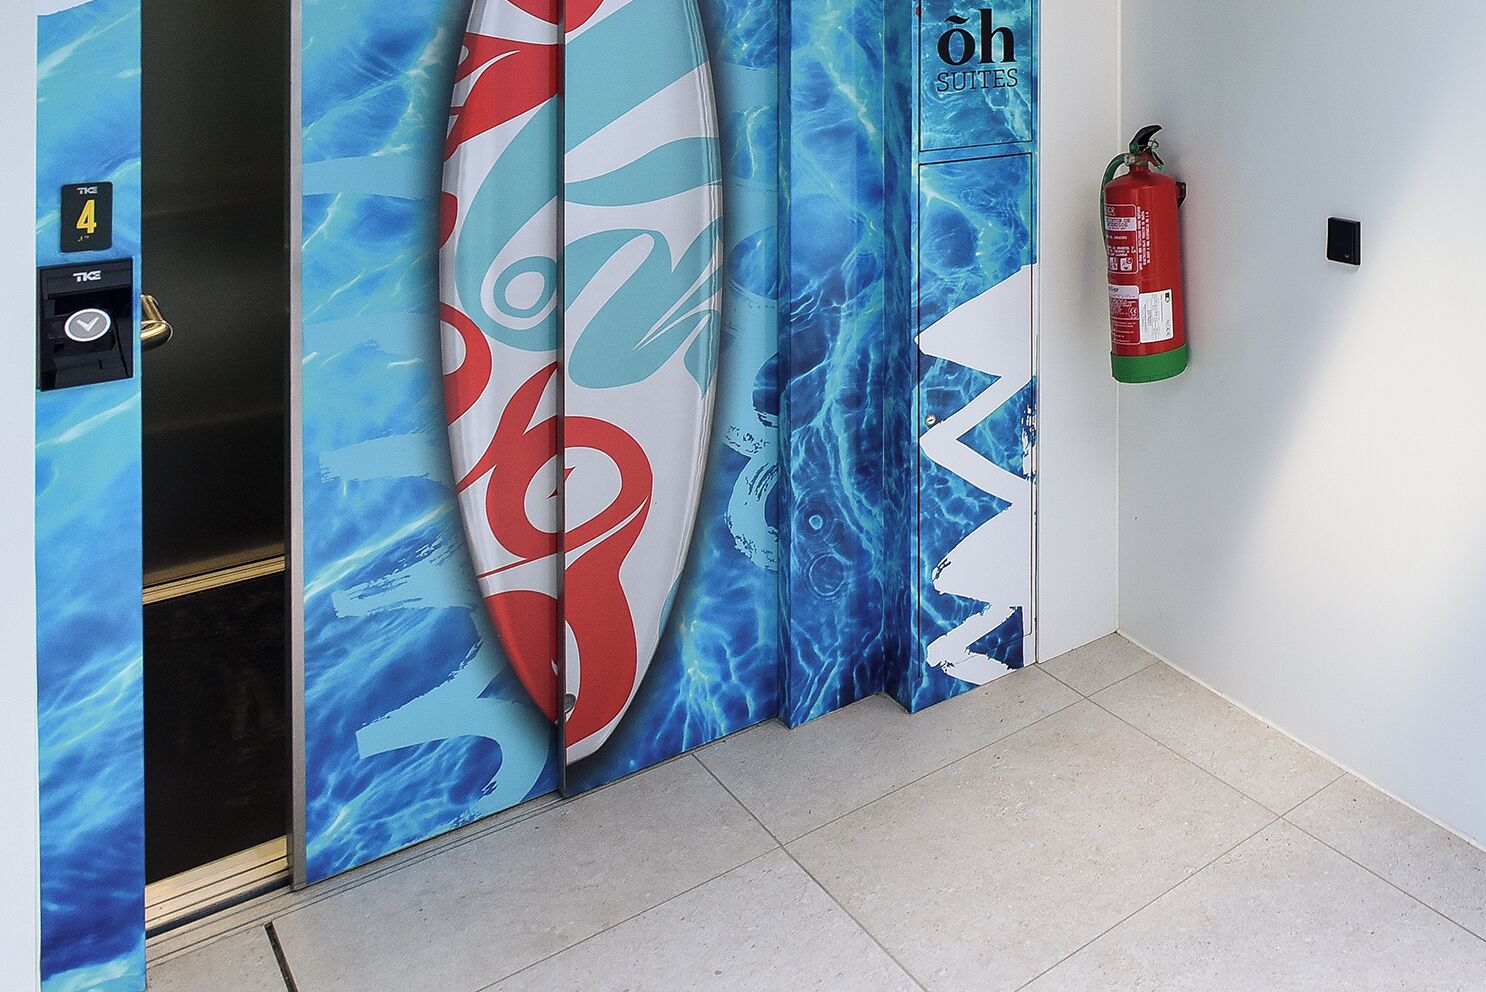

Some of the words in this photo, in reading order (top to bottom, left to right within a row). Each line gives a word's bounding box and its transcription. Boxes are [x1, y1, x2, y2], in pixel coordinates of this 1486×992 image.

[937, 8, 1018, 66] õh
[936, 68, 1018, 92] SUITES
[77, 186, 98, 195] TKE
[76, 199, 97, 234] 4
[72, 270, 102, 283] TKE
